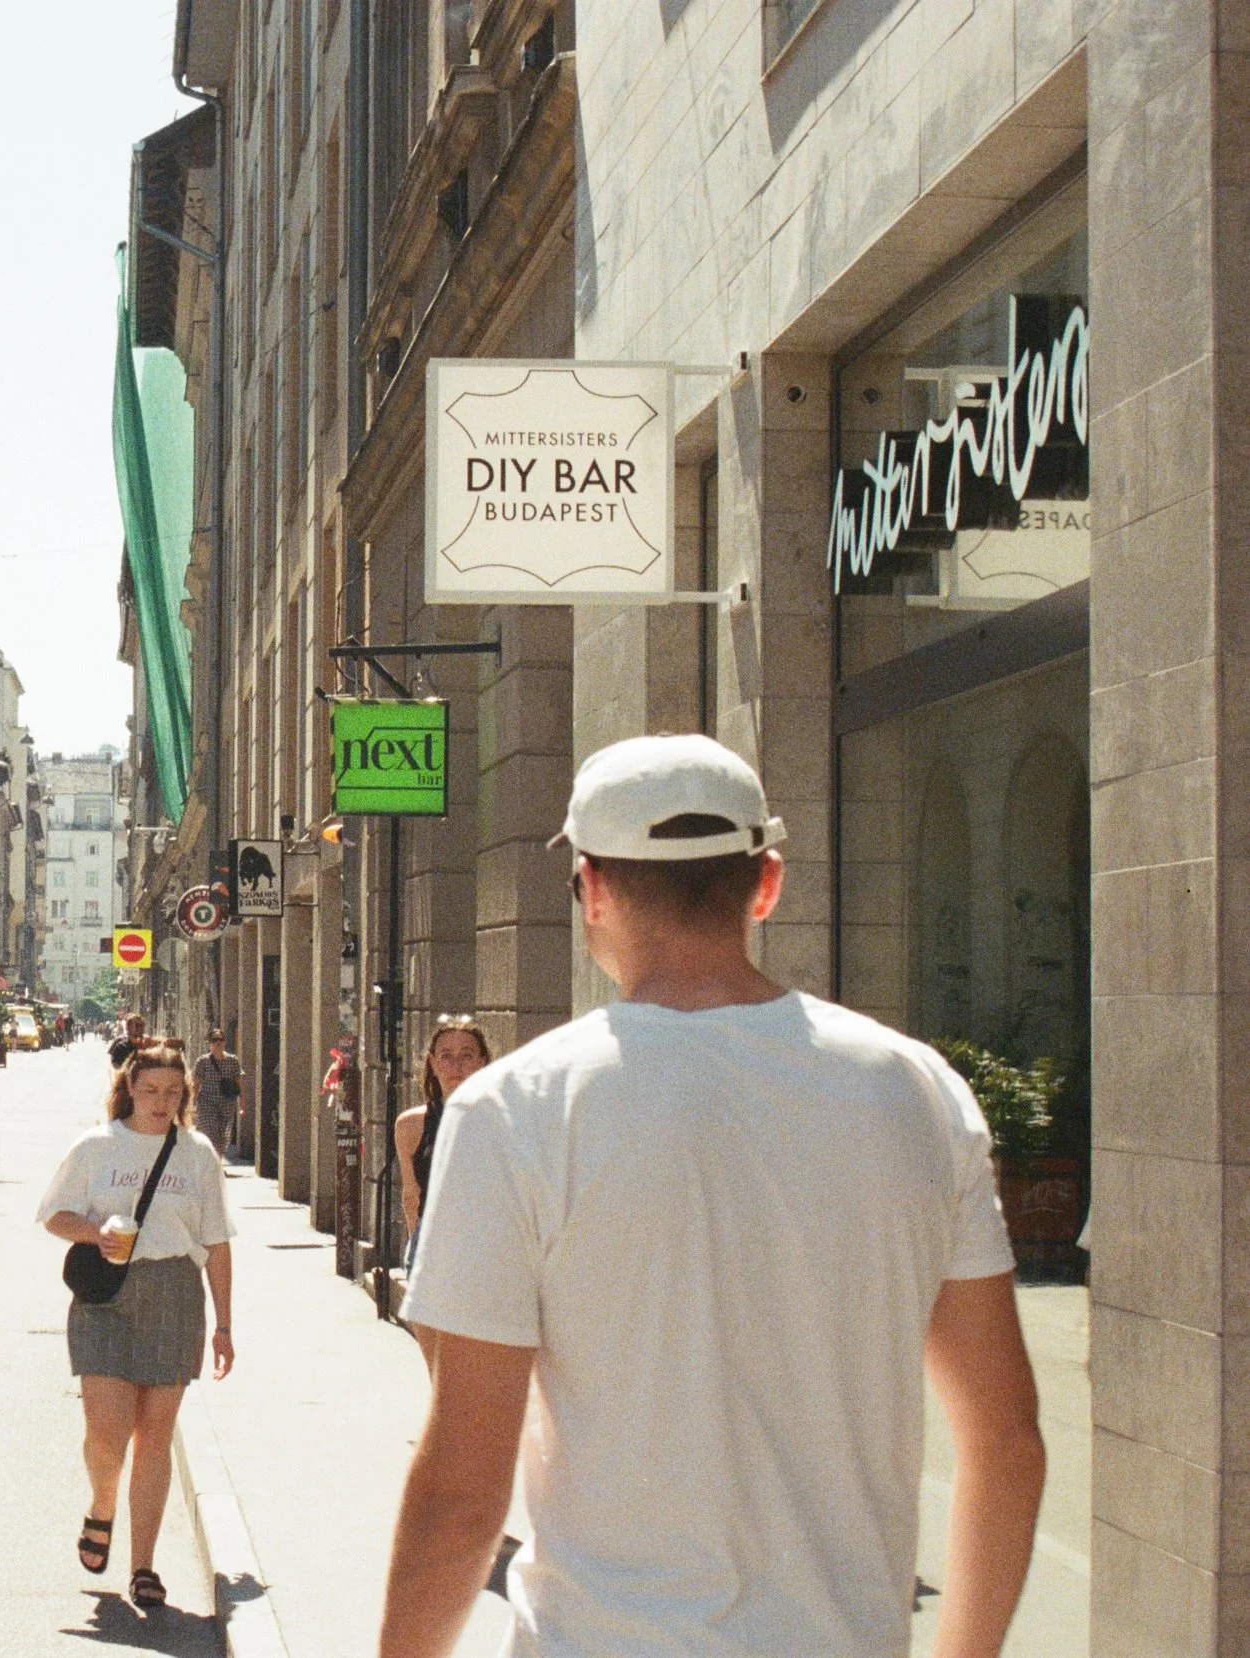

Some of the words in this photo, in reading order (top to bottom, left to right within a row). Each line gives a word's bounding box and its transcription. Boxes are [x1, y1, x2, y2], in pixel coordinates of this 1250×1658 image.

[485, 432, 619, 447] MITTERSISTERS
[466, 457, 537, 493] DIY
[555, 458, 638, 494] BAR
[485, 502, 619, 522] BUDAPEST
[341, 733, 442, 771] next
[417, 773, 442, 785] bar
[110, 1168, 139, 1187] Lee
